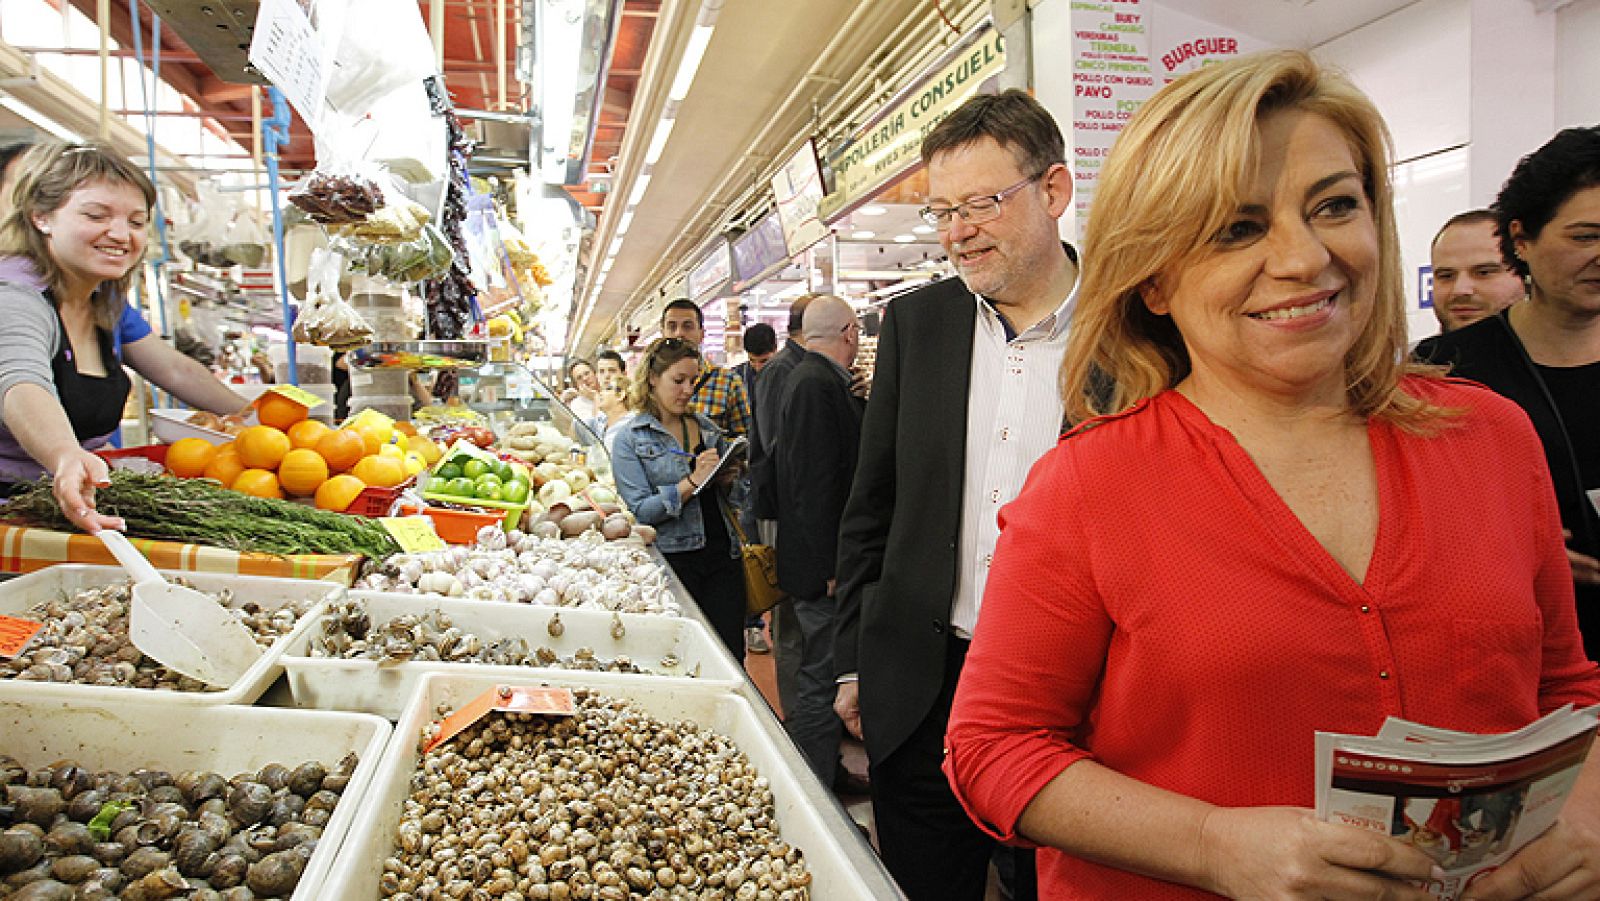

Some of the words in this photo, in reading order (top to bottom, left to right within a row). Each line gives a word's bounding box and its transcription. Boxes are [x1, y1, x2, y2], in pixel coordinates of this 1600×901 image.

[1115, 13, 1140, 23] BUEY
[1161, 37, 1239, 72] BURGUER
[1075, 60, 1106, 70] CINCO
[1073, 73, 1102, 83] POLLO
[1104, 75, 1123, 84] CON
[1125, 77, 1153, 86] QUESO
[1075, 85, 1112, 99] PAVO
[1117, 100, 1142, 111] POT
[1085, 110, 1115, 120] POLLO
[1074, 121, 1099, 131] POLLO
